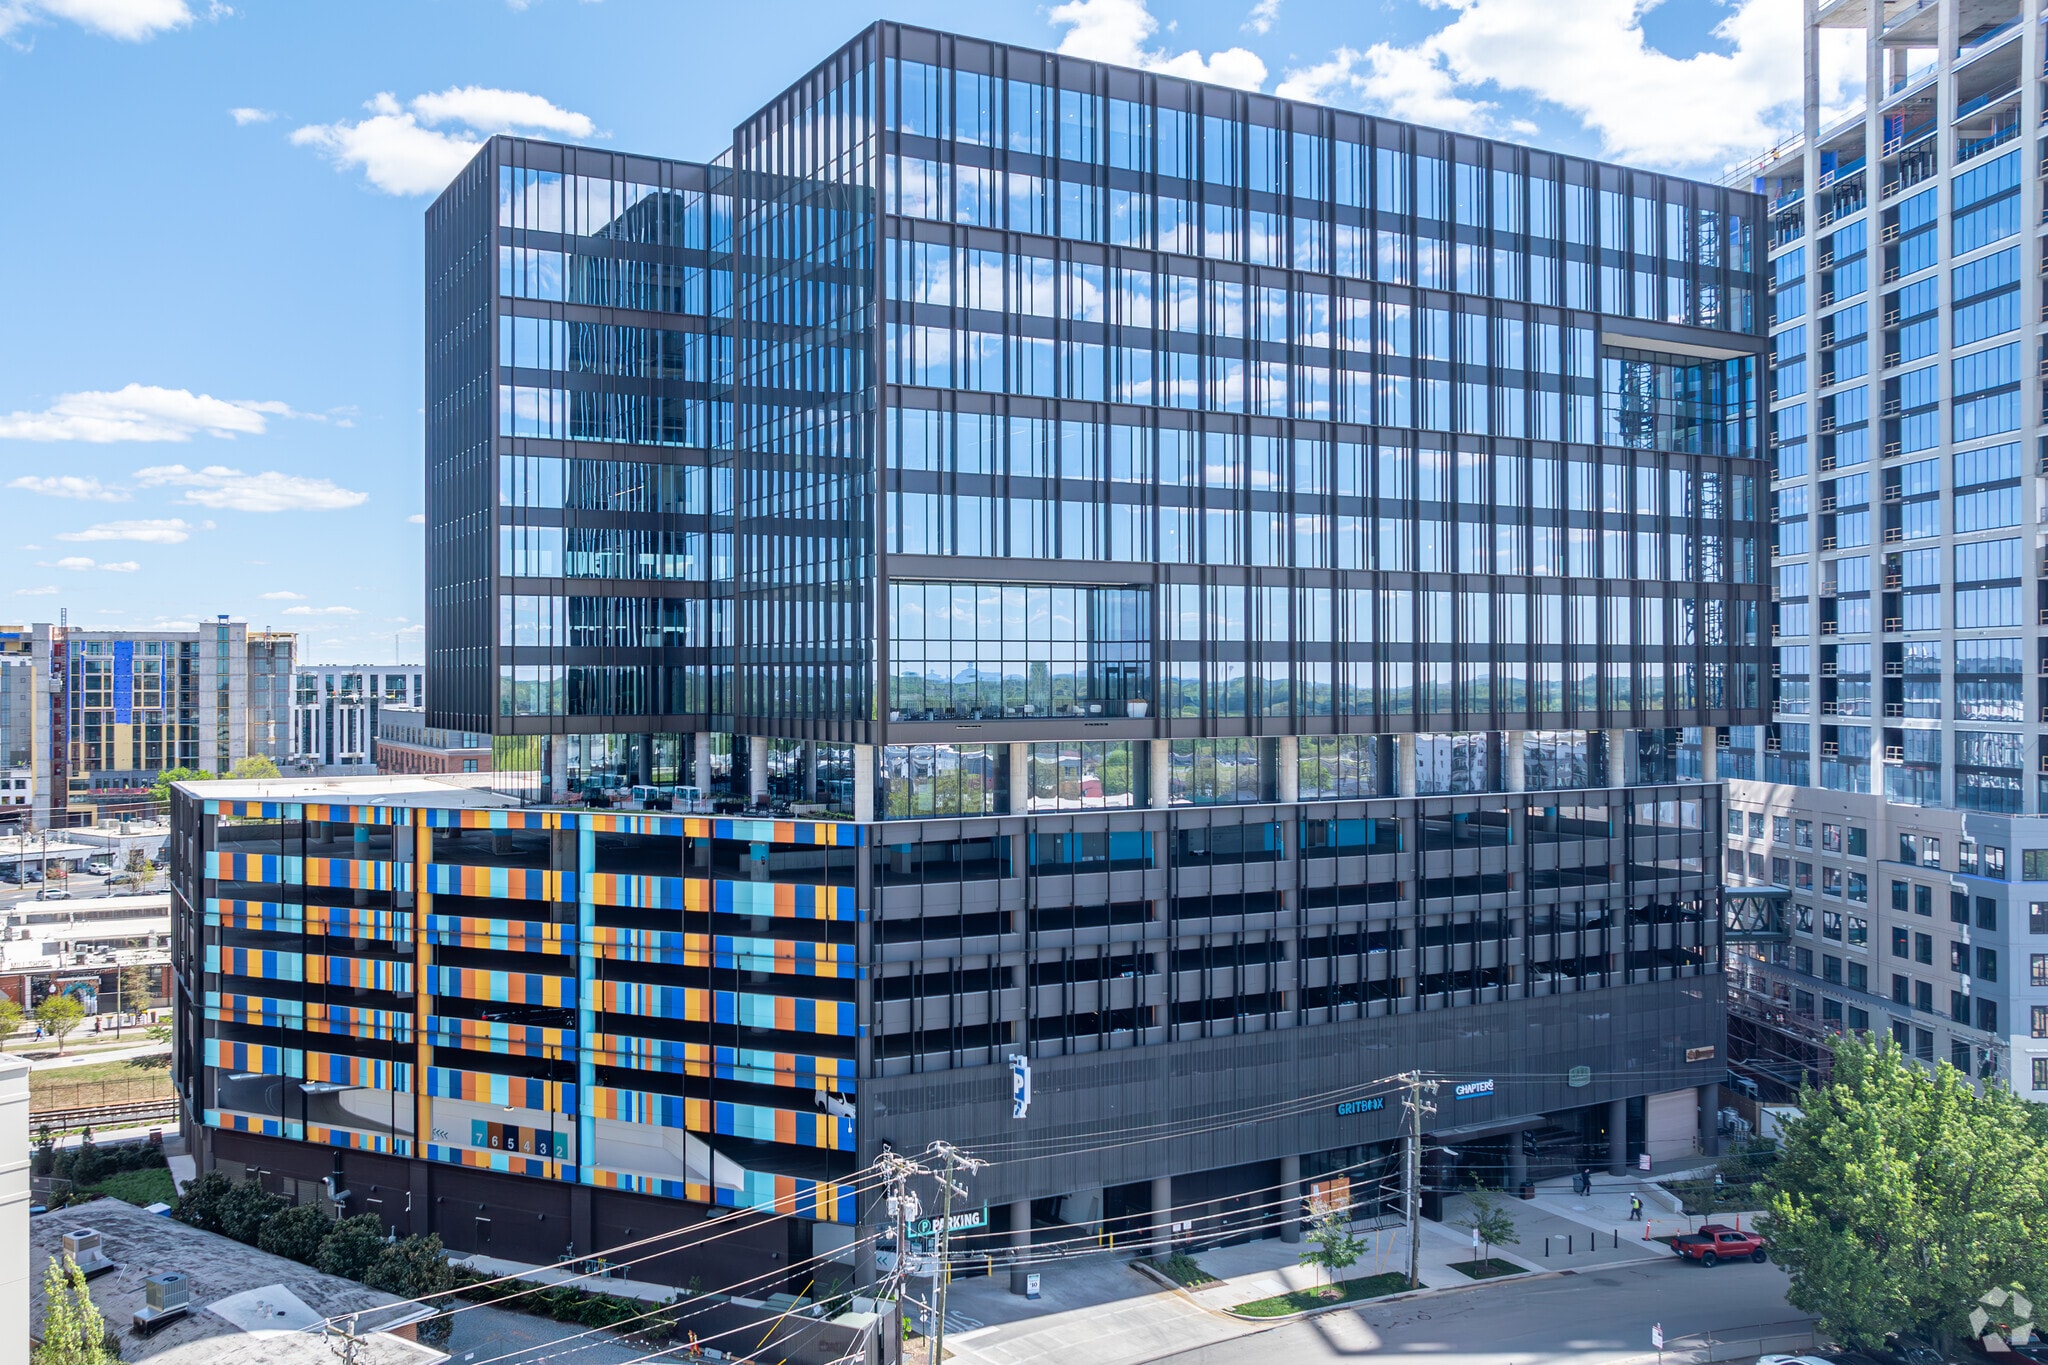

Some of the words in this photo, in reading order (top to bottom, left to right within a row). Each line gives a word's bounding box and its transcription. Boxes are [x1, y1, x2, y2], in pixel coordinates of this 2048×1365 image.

[1014, 1073, 1023, 1094] P
[1455, 1079, 1494, 1095] CHAPTERS
[475, 1133, 483, 1145] 7
[491, 1135, 499, 1147] 6
[507, 1138, 515, 1150] 5
[524, 1140, 531, 1152] 4
[540, 1143, 547, 1155] 3
[556, 1146, 563, 1157] 2
[933, 1212, 980, 1231] PARKING
